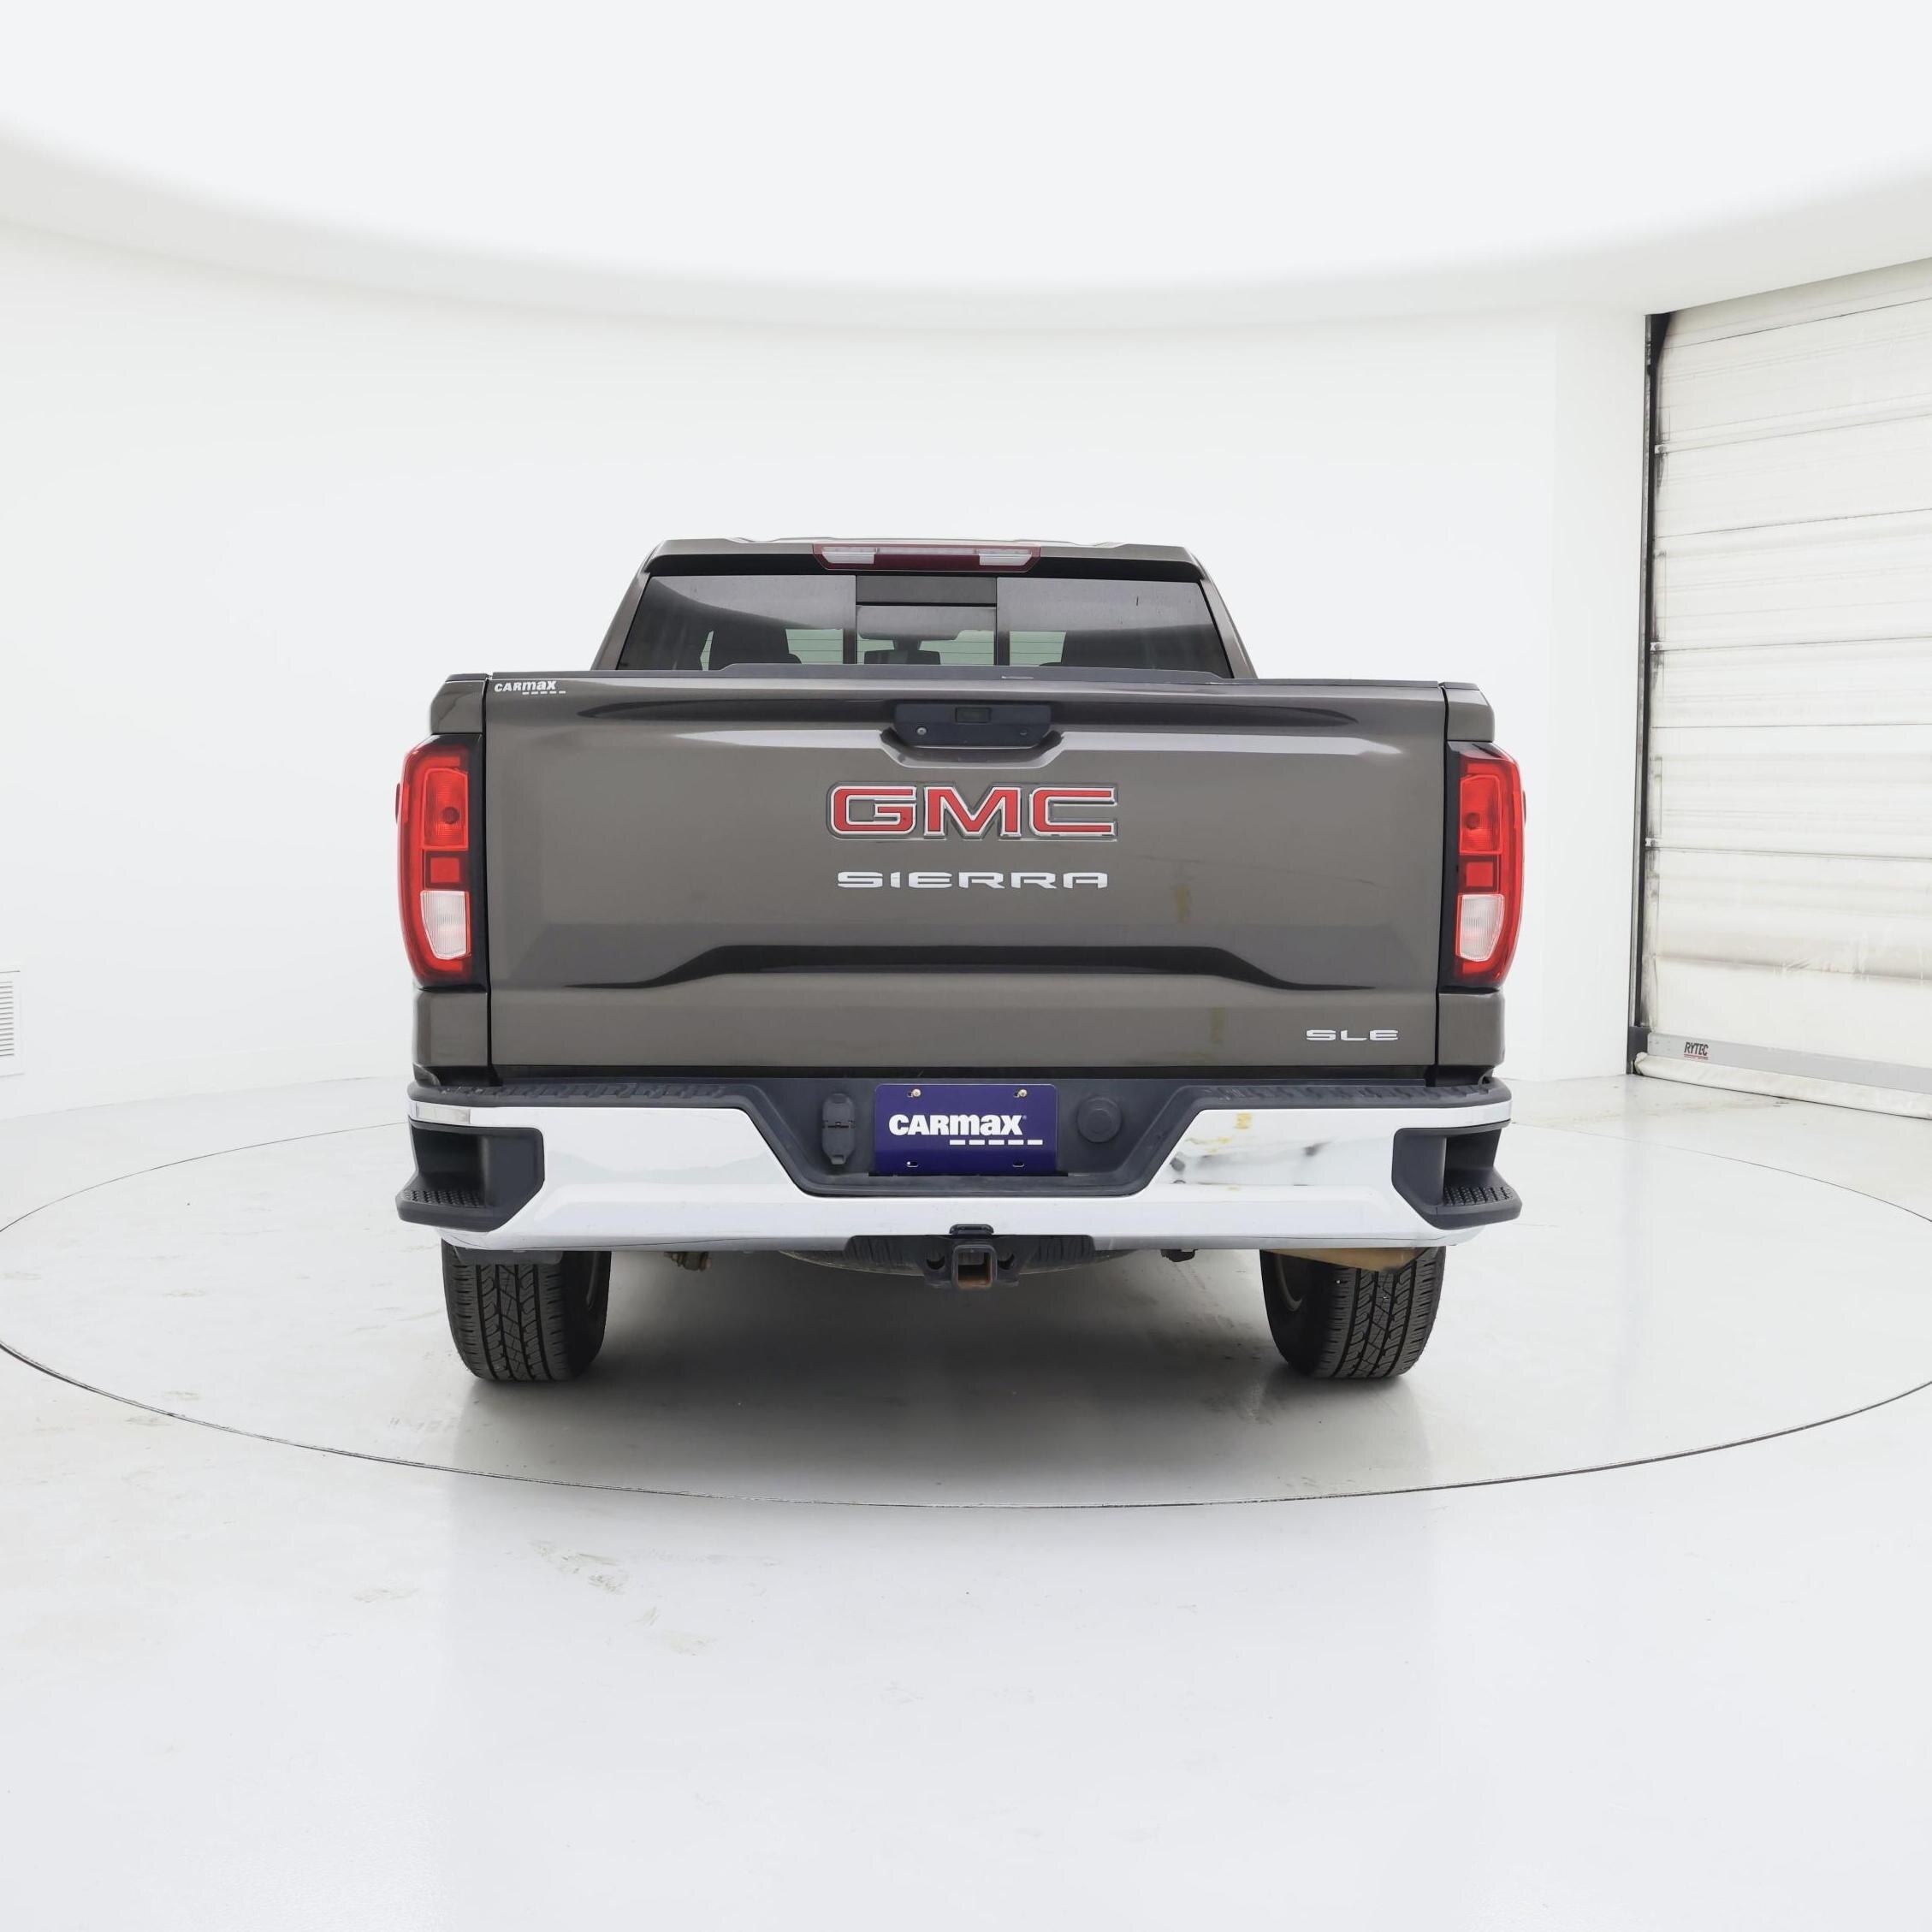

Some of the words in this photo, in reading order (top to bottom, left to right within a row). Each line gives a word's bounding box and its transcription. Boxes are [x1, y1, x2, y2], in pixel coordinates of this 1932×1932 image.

[494, 680, 557, 692] CARmax
[830, 785, 1117, 838] GMC
[838, 871, 1109, 889] SIERRA
[1306, 1029, 1399, 1041] SLE
[1684, 1041, 1709, 1056] RYTEC
[888, 1114, 1023, 1136] CARmax
